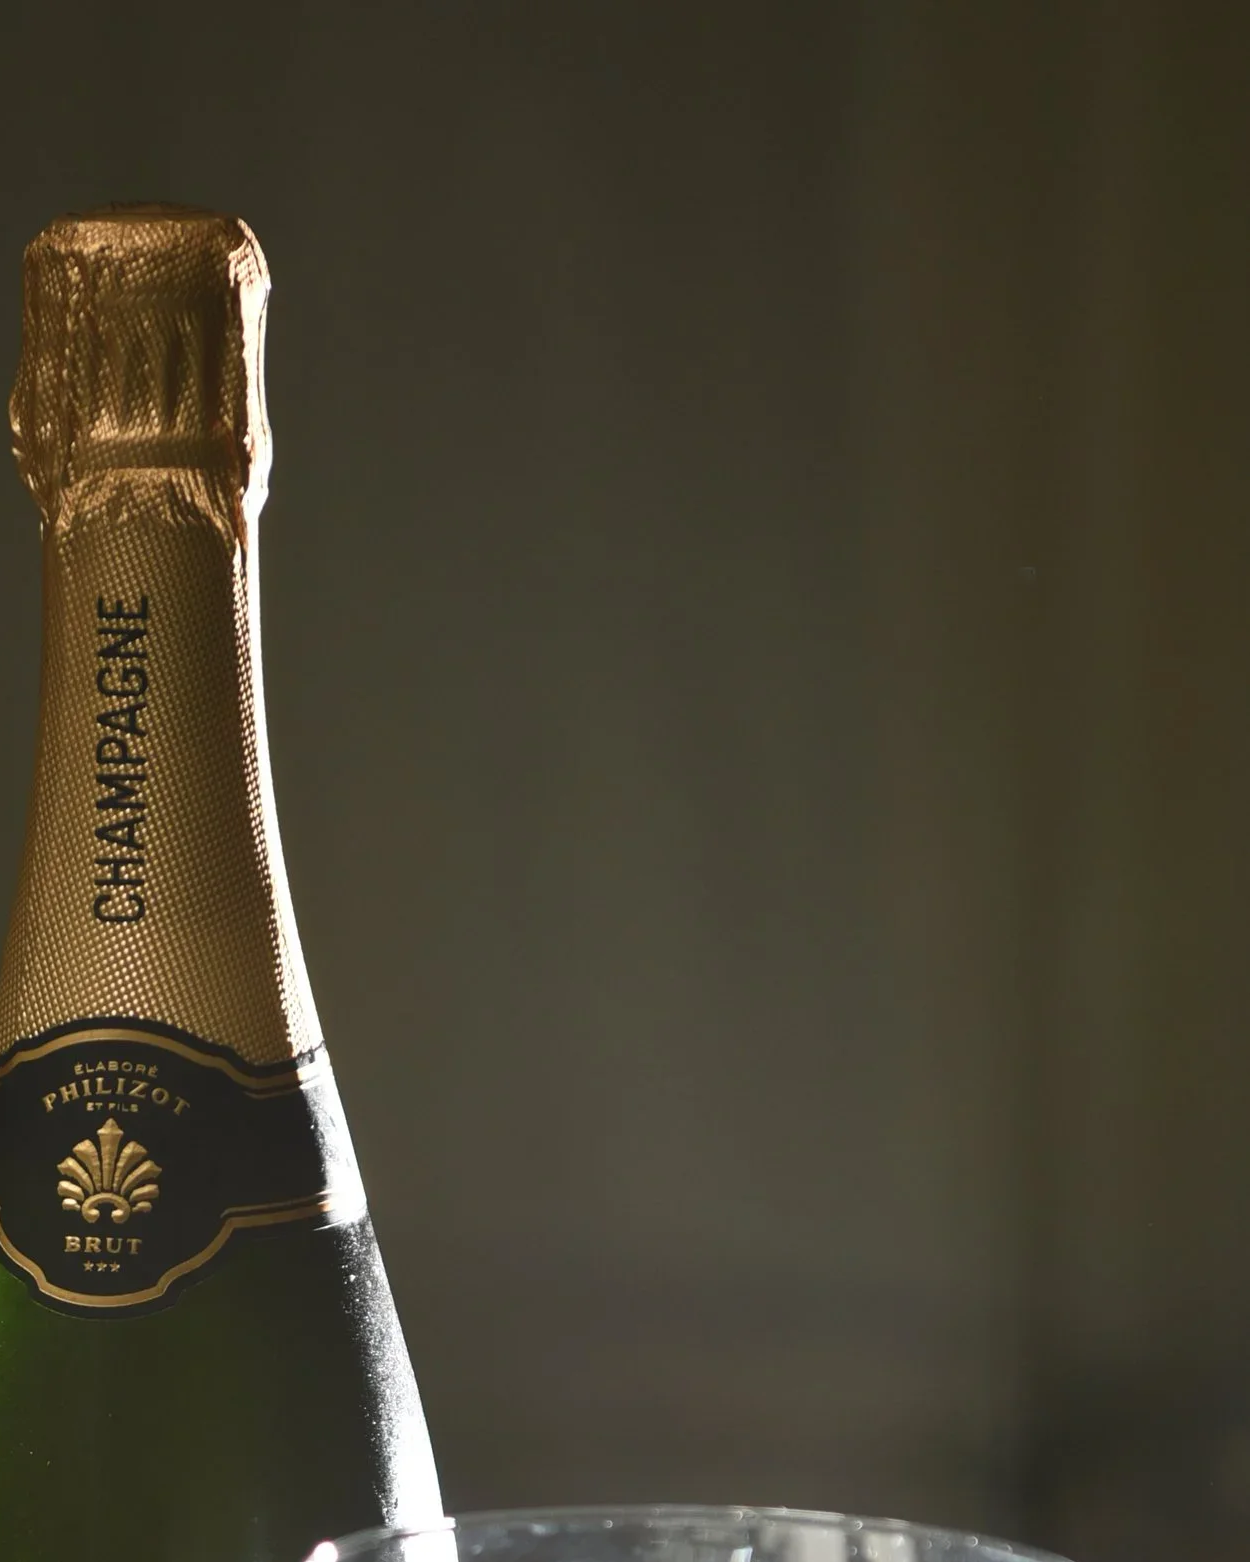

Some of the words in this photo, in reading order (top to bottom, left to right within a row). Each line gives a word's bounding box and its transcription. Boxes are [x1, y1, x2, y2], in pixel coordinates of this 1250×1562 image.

[94, 595, 148, 924] CHAMPAGNE
[73, 1060, 159, 1079] ÉLABORÉ
[42, 1077, 191, 1116] PHILIZOT
[86, 1102, 103, 1112] ET
[108, 1102, 139, 1113] FILS
[64, 1235, 143, 1256] BRUT
